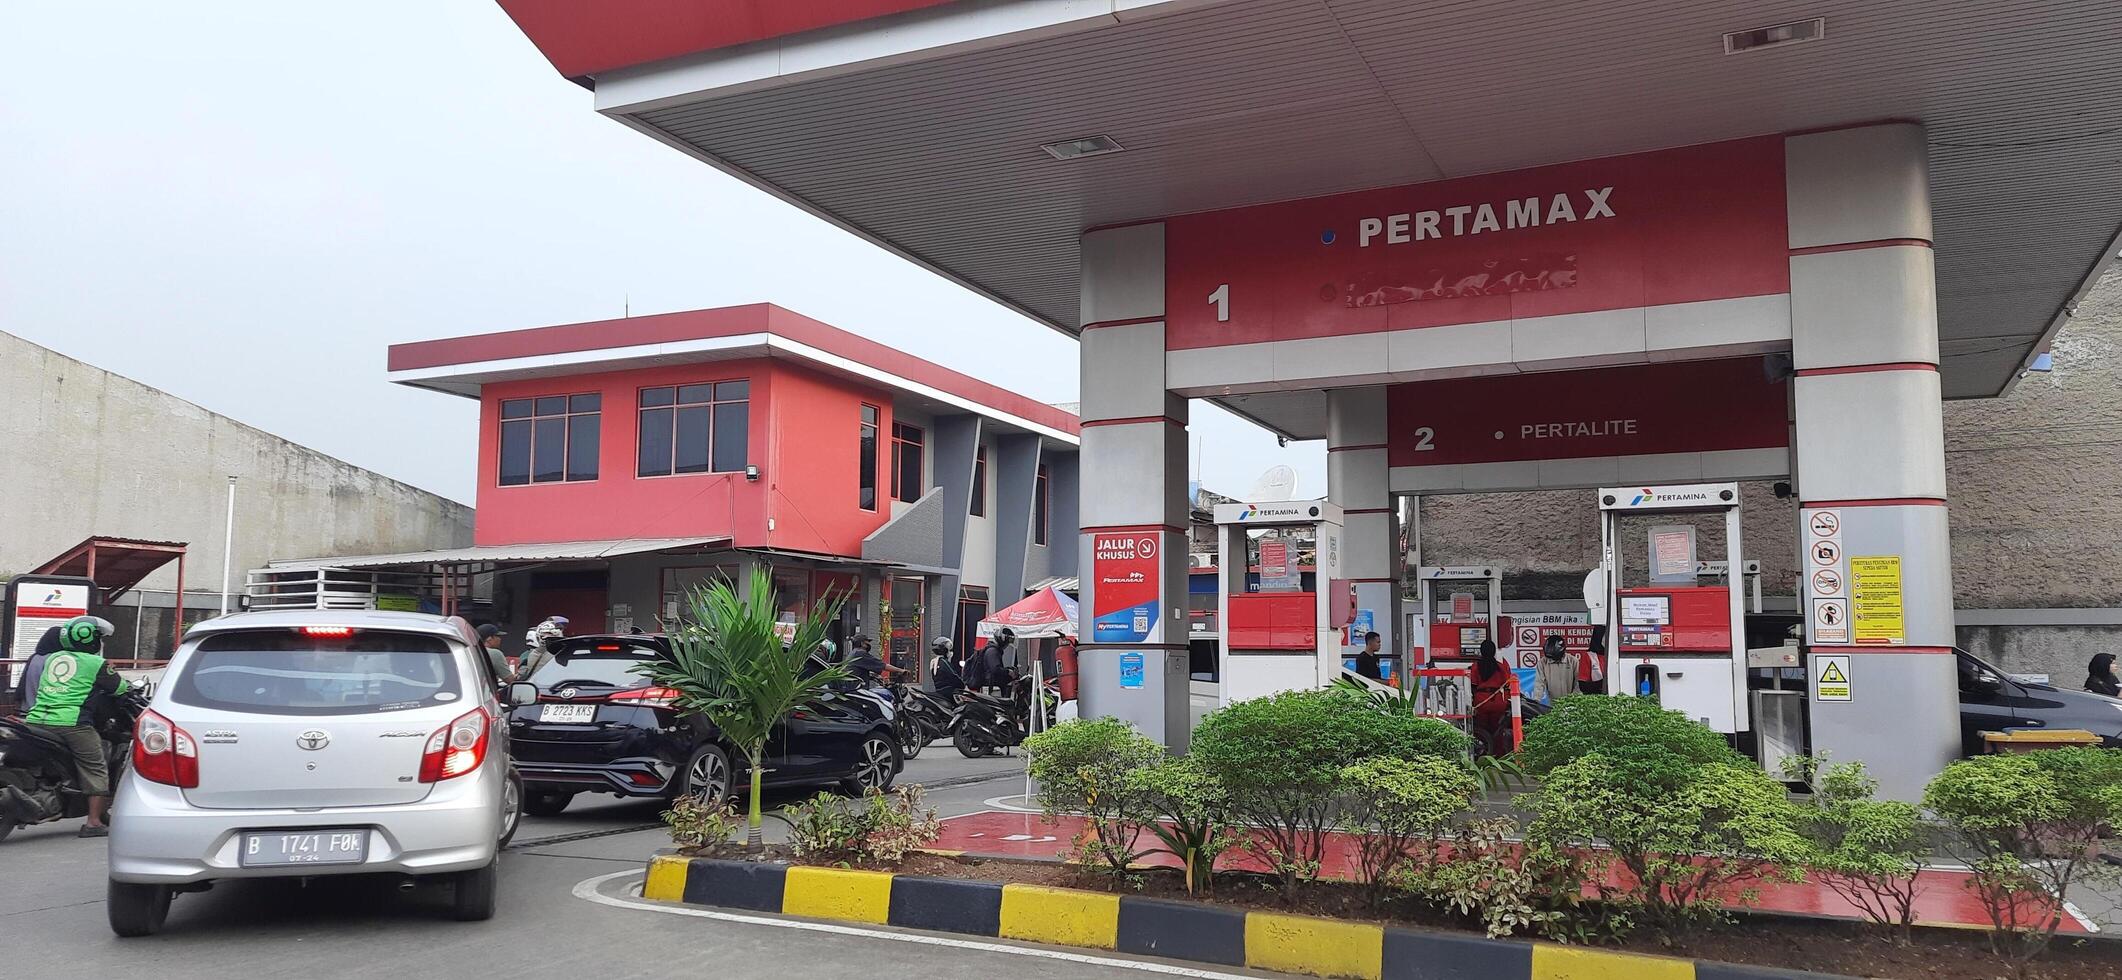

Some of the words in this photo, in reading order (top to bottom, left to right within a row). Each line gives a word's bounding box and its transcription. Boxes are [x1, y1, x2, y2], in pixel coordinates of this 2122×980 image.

[1359, 186, 1617, 247] PERTAMAX
[1207, 284, 1230, 322] 1
[1520, 419, 1638, 439] PERTALITE
[1414, 427, 1435, 451] 2
[1657, 493, 1707, 501] PERTAMINA
[1097, 539, 1134, 550] JALUR
[1097, 551, 1135, 560] KHUSUS
[1563, 616, 1578, 625] jika
[1542, 628, 1565, 636] MESIN
[1567, 637, 1575, 645] DI
[543, 705, 551, 716] B
[553, 705, 574, 716] 2723
[576, 705, 593, 717] KKS
[248, 836, 260, 855] B
[281, 834, 320, 853] 1741
[289, 854, 320, 862] 07-24
